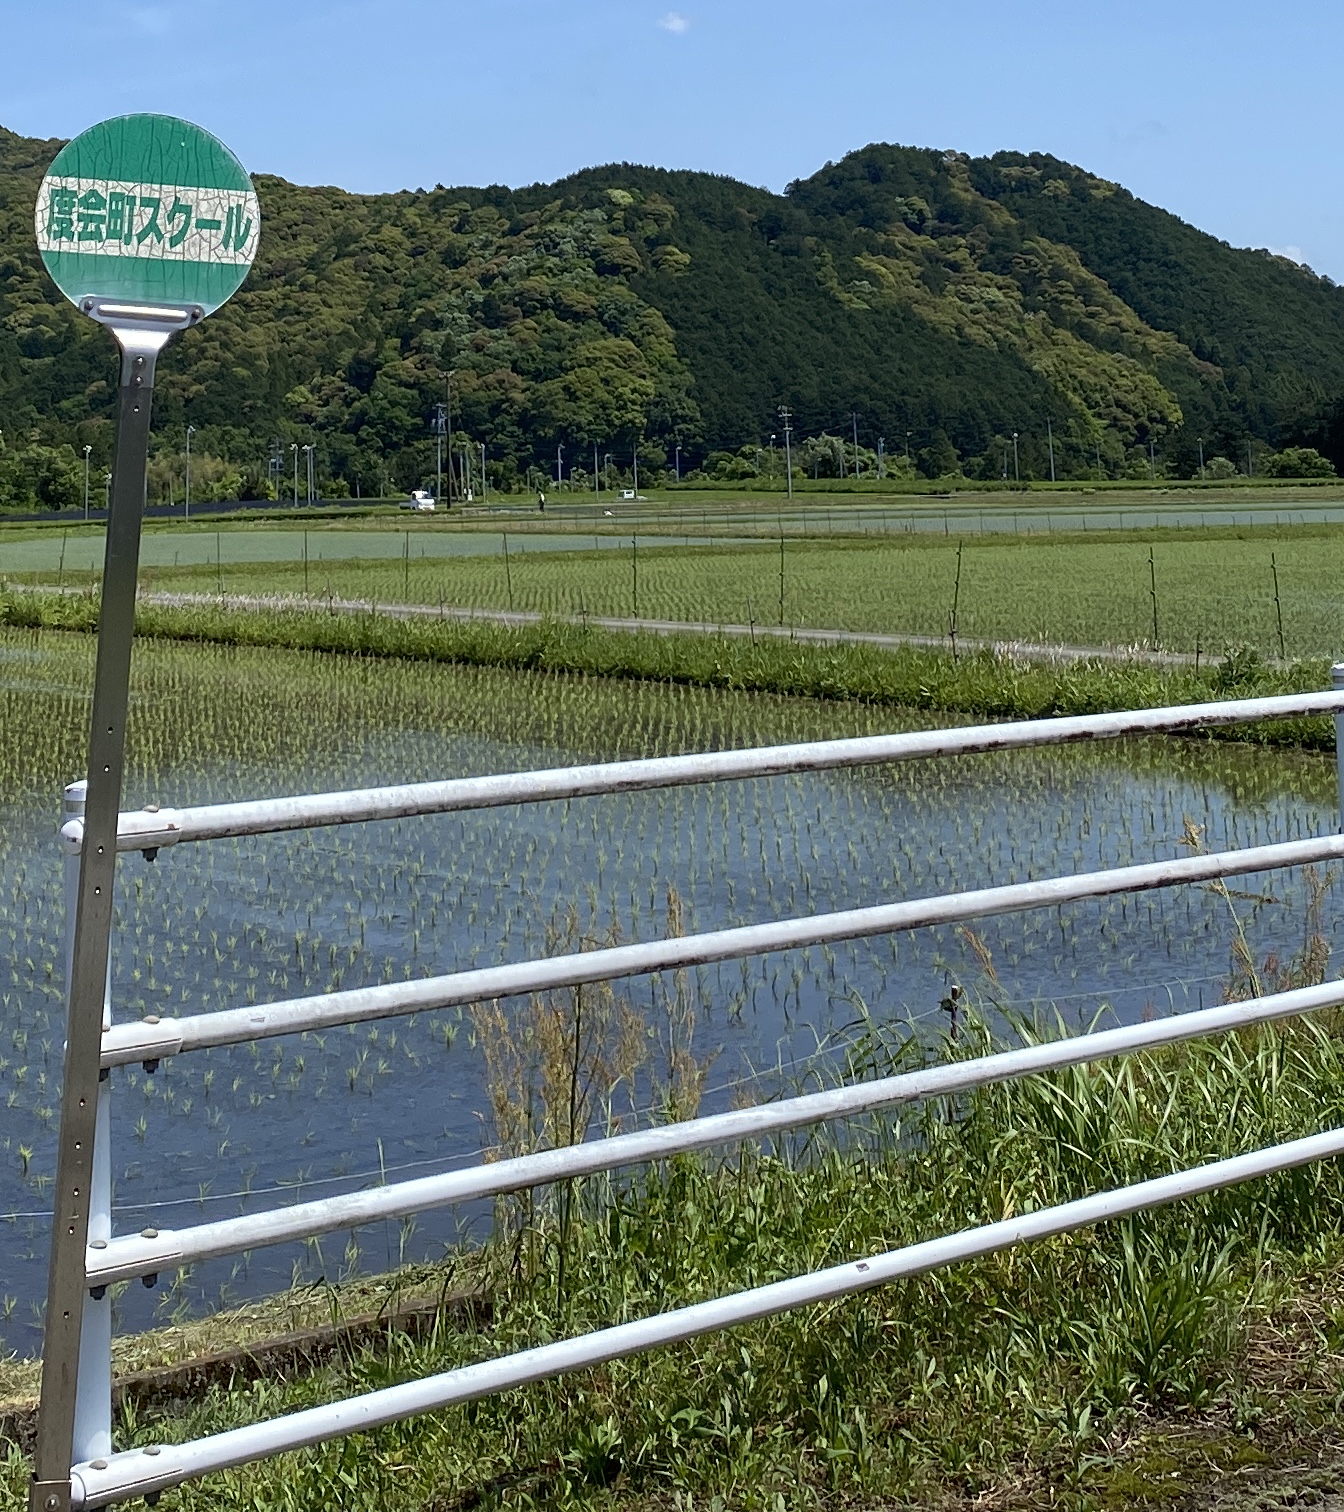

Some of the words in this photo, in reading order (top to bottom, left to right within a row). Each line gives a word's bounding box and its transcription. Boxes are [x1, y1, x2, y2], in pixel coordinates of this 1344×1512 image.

[46, 186, 253, 252] 度会町スクール
